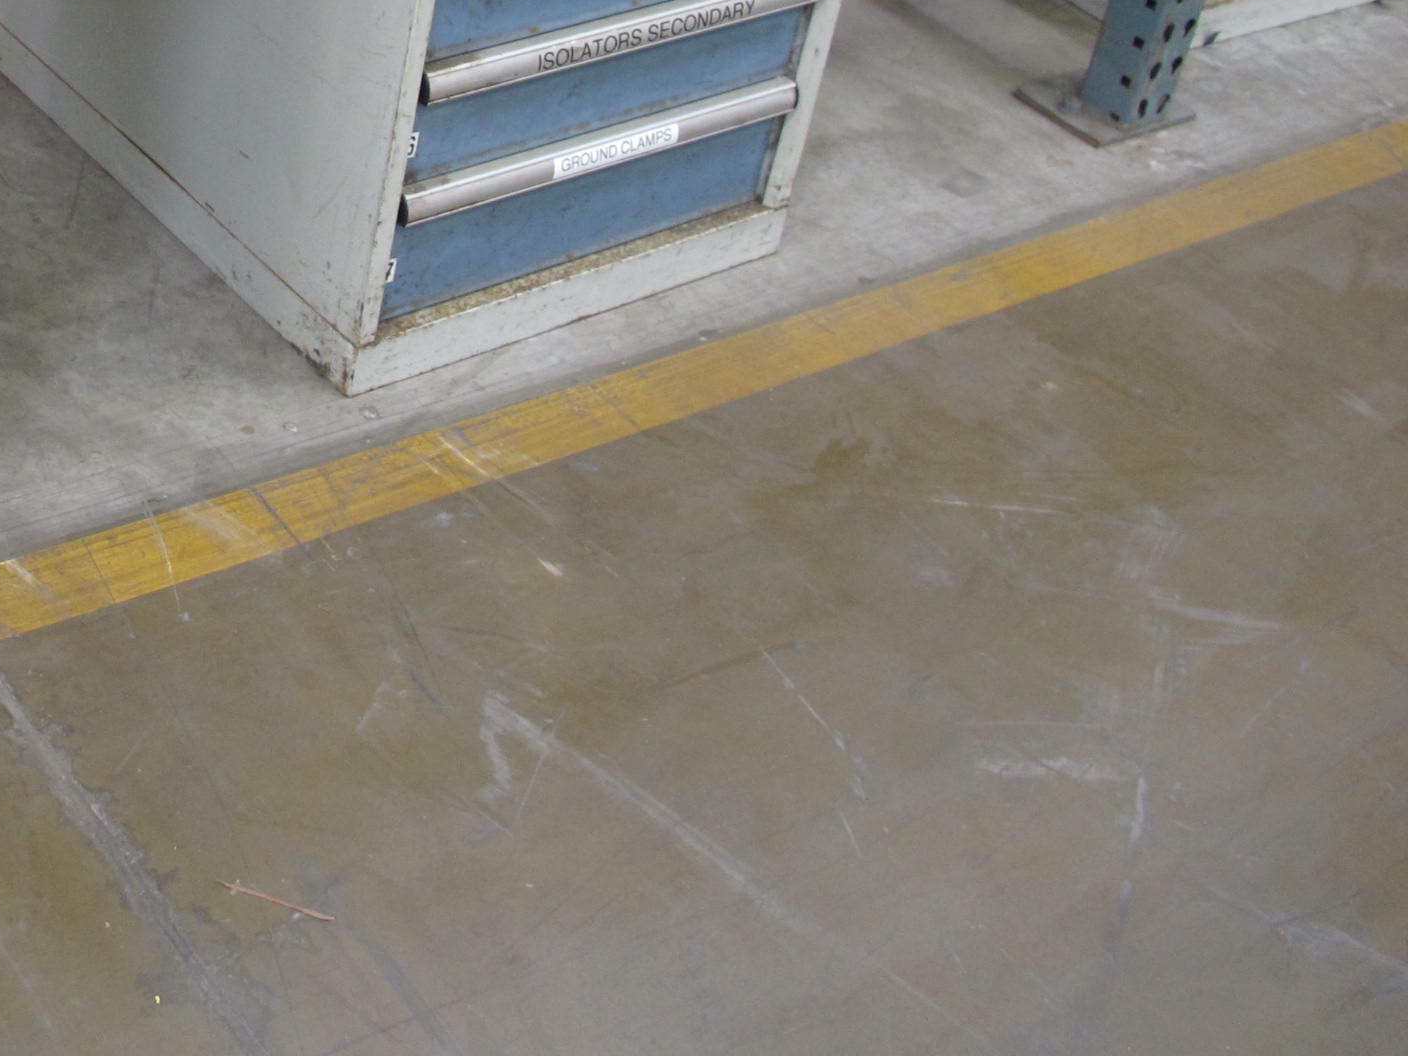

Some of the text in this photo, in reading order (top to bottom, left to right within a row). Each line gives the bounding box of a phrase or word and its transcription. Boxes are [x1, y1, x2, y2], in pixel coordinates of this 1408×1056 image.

[538, 0, 756, 72] ISOLATORS SECONDARY
[561, 127, 674, 172] GROUND CLAMPS
